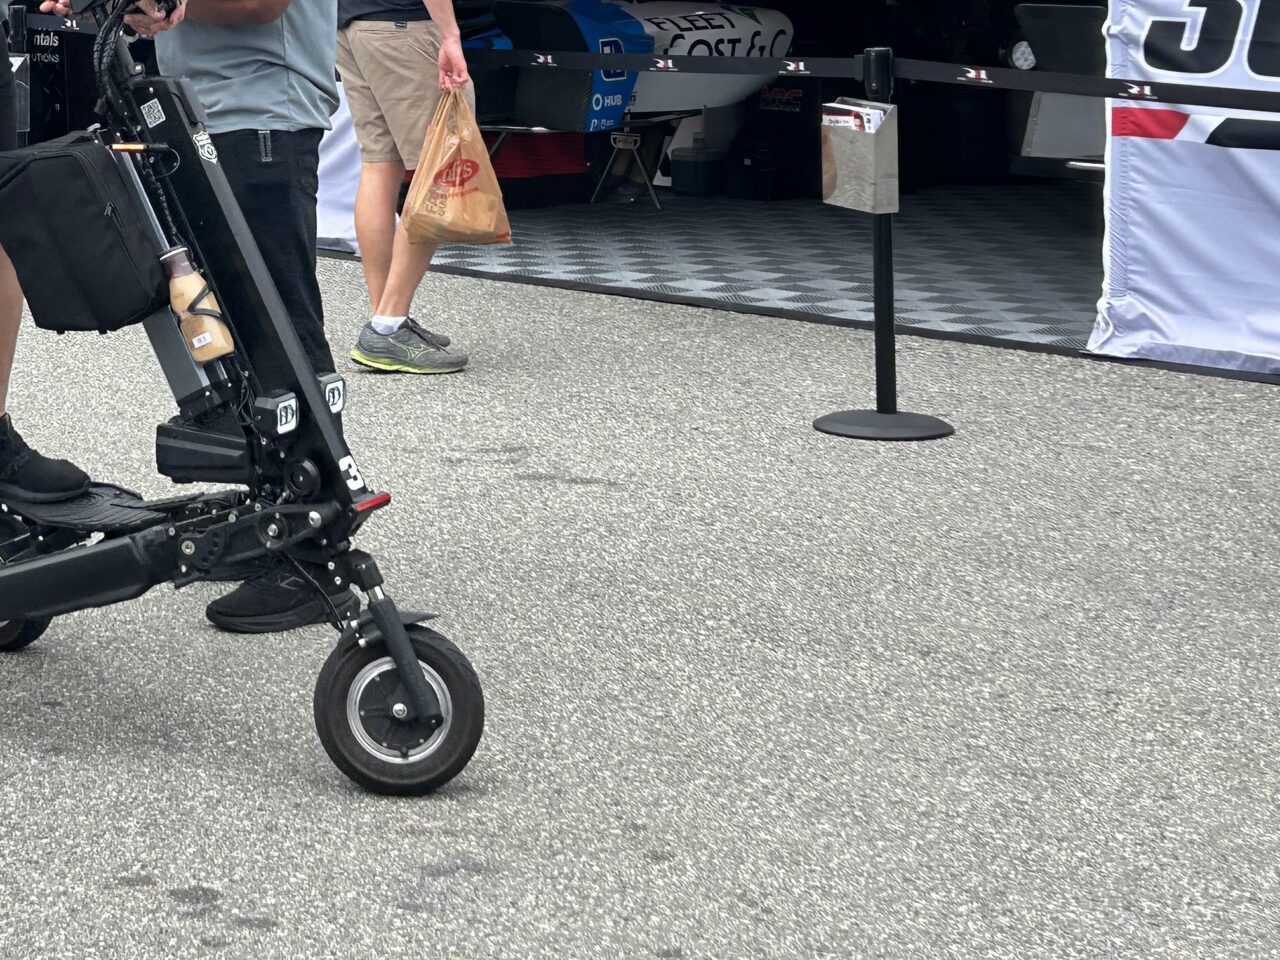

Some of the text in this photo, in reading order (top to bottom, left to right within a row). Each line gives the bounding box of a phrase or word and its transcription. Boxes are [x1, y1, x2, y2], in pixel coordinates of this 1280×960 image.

[643, 12, 736, 32] FLEET
[604, 94, 623, 107] HUB
[339, 455, 365, 491] 3
